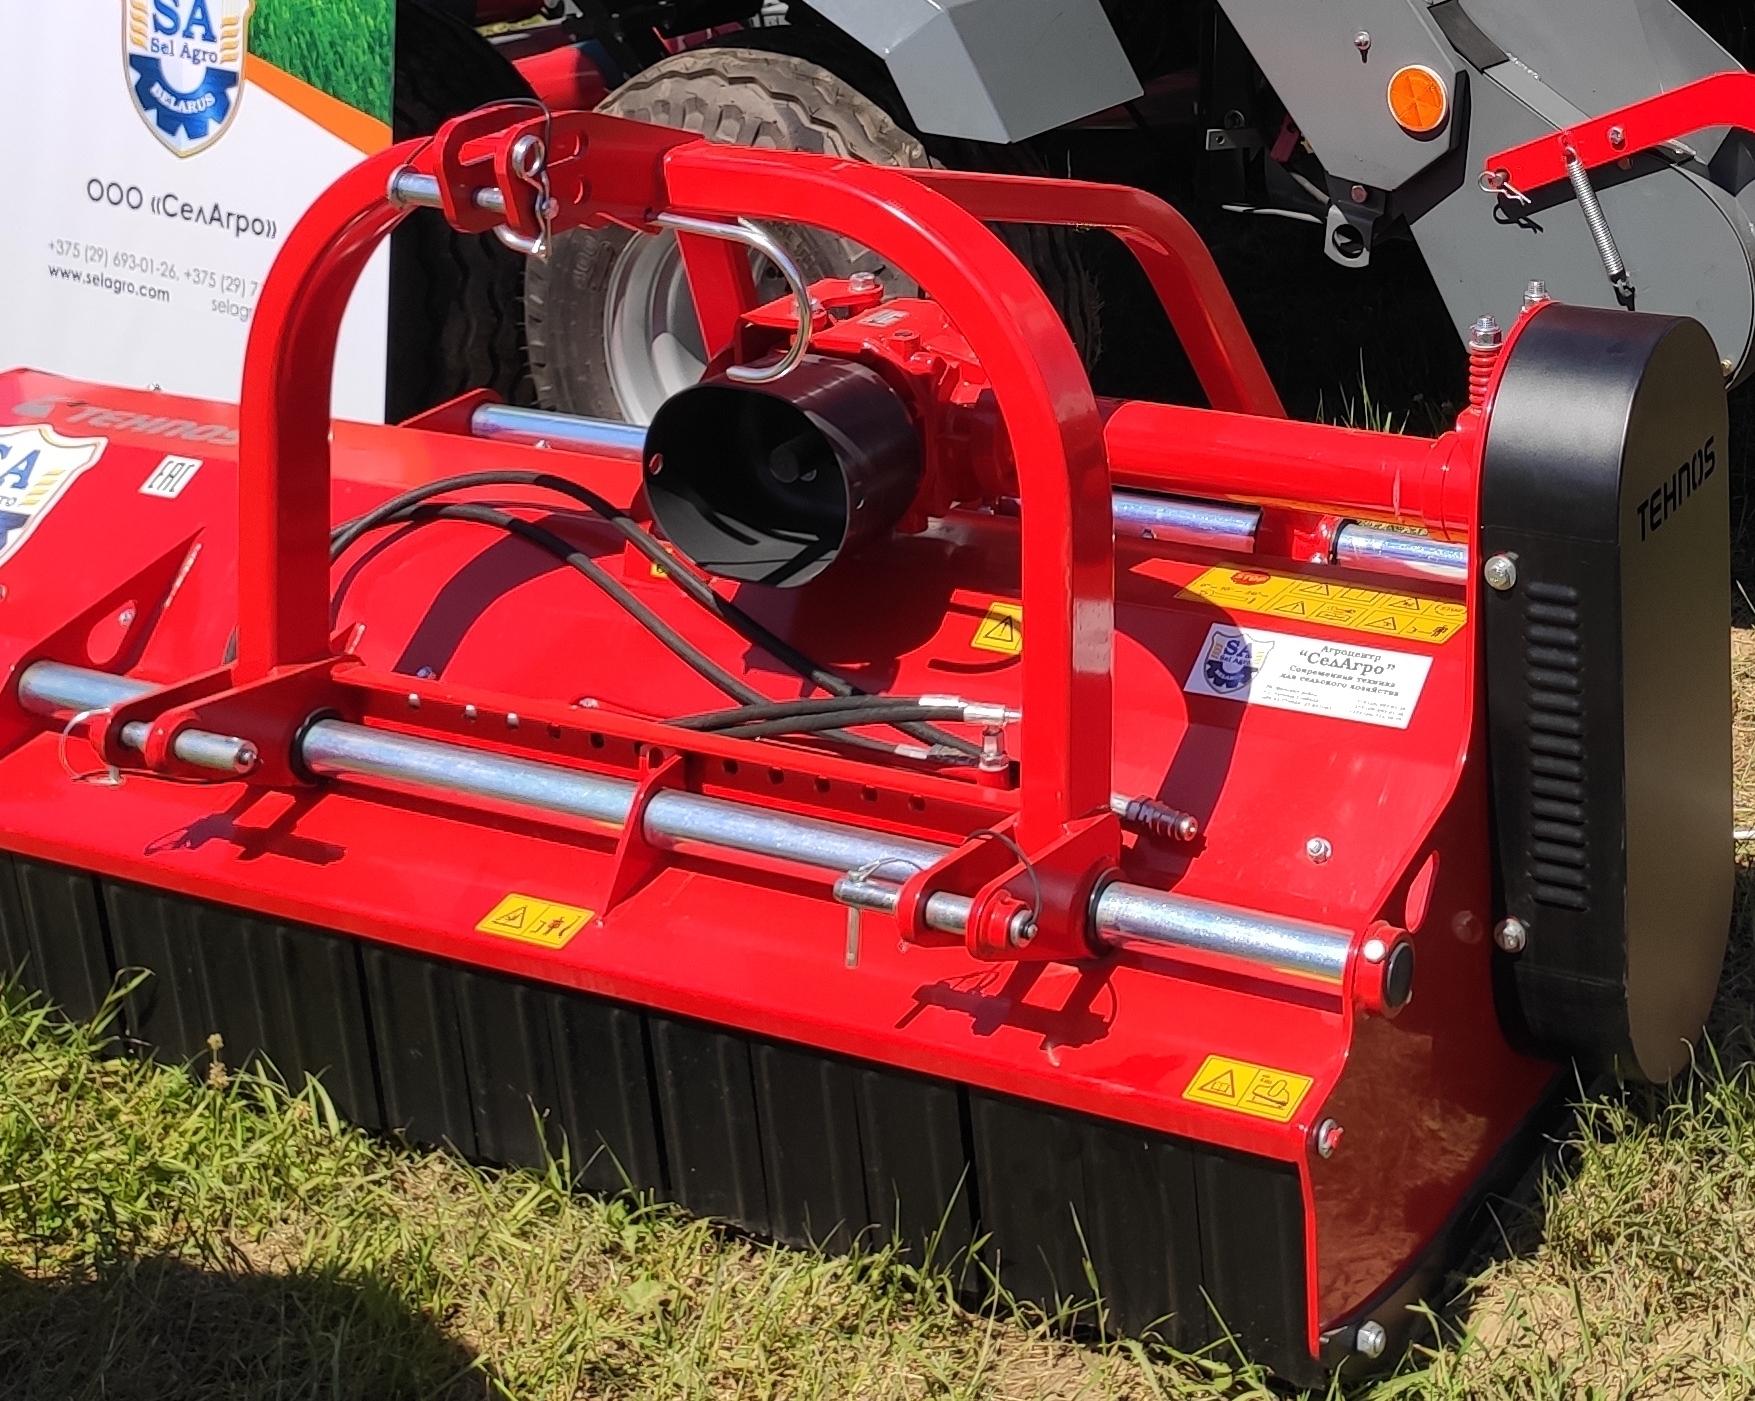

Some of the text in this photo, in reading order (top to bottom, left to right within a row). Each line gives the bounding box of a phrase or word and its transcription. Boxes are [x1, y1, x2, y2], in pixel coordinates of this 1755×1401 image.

[152, 0, 216, 42] SA
[151, 38, 217, 64] Sel Agro
[87, 178, 143, 209] ООО
[48, 238, 81, 259] +375
[85, 244, 108, 267] (29)
[184, 267, 217, 289] +375
[221, 274, 246, 298] (29)
[48, 264, 170, 303] www.selagro.com
[1636, 435, 1716, 542] TEHNOS
[1321, 646, 1382, 662] Агроцентр
